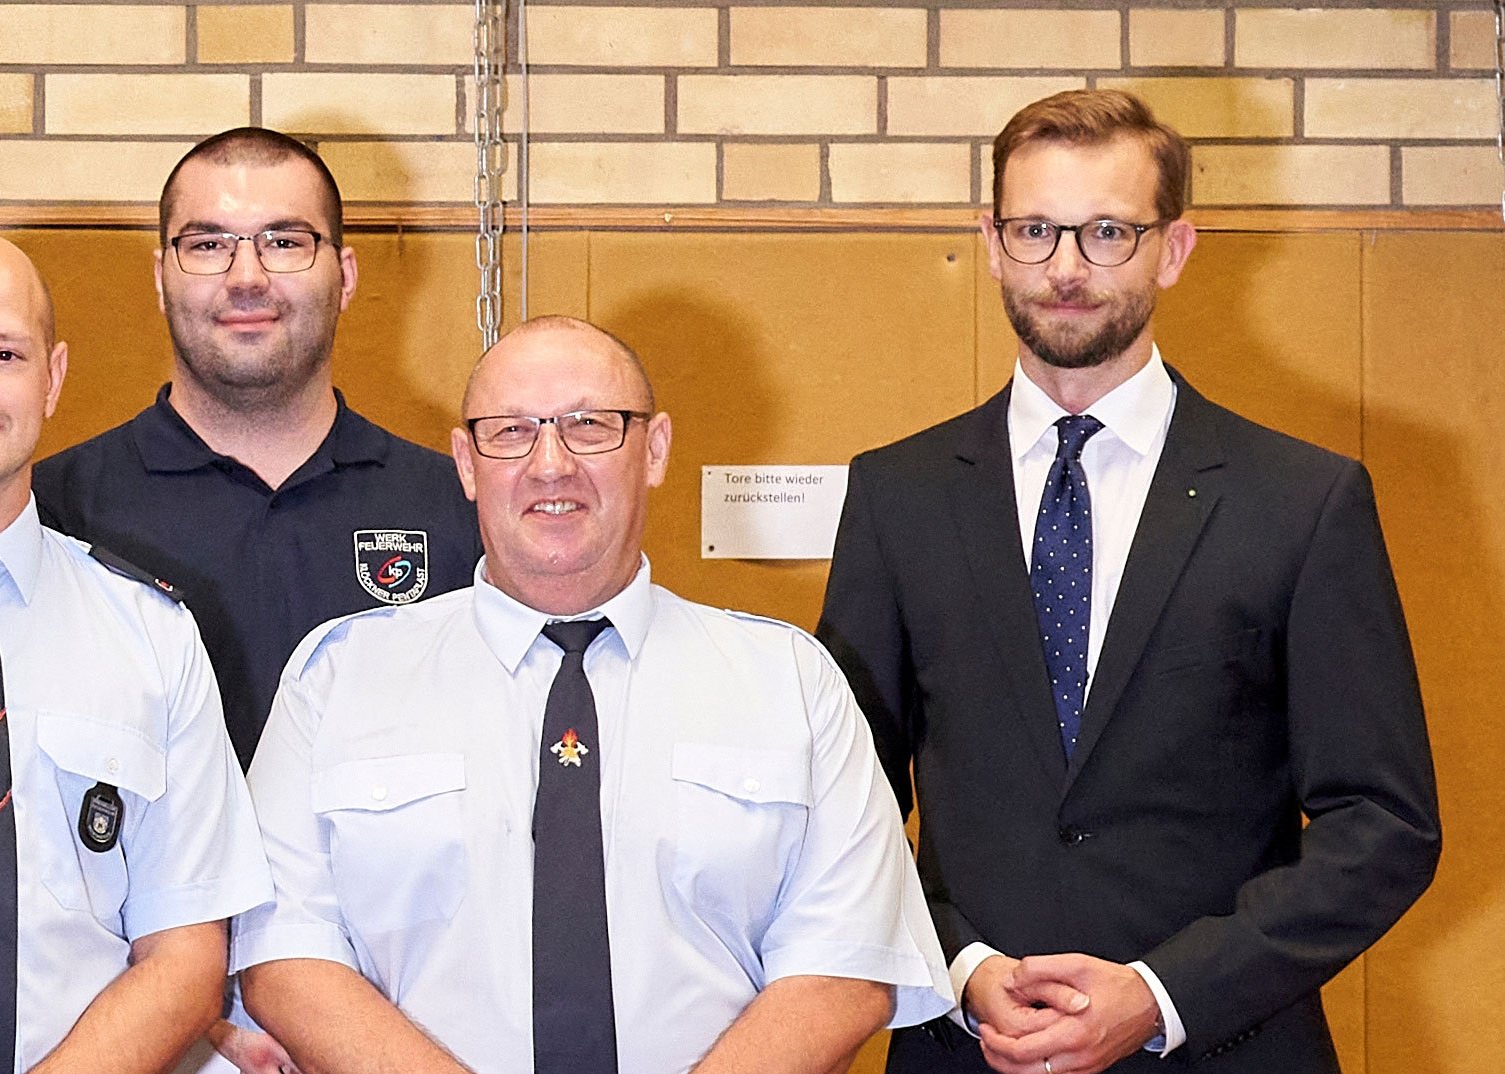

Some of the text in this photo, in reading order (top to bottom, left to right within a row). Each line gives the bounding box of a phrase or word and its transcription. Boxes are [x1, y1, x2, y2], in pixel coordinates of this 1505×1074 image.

[725, 472, 823, 485] Tore bitte wieder
[724, 491, 805, 503] zurückstellen!
[374, 533, 407, 543] WERK
[358, 541, 424, 553] FEUERWEHR
[388, 565, 403, 580] kp
